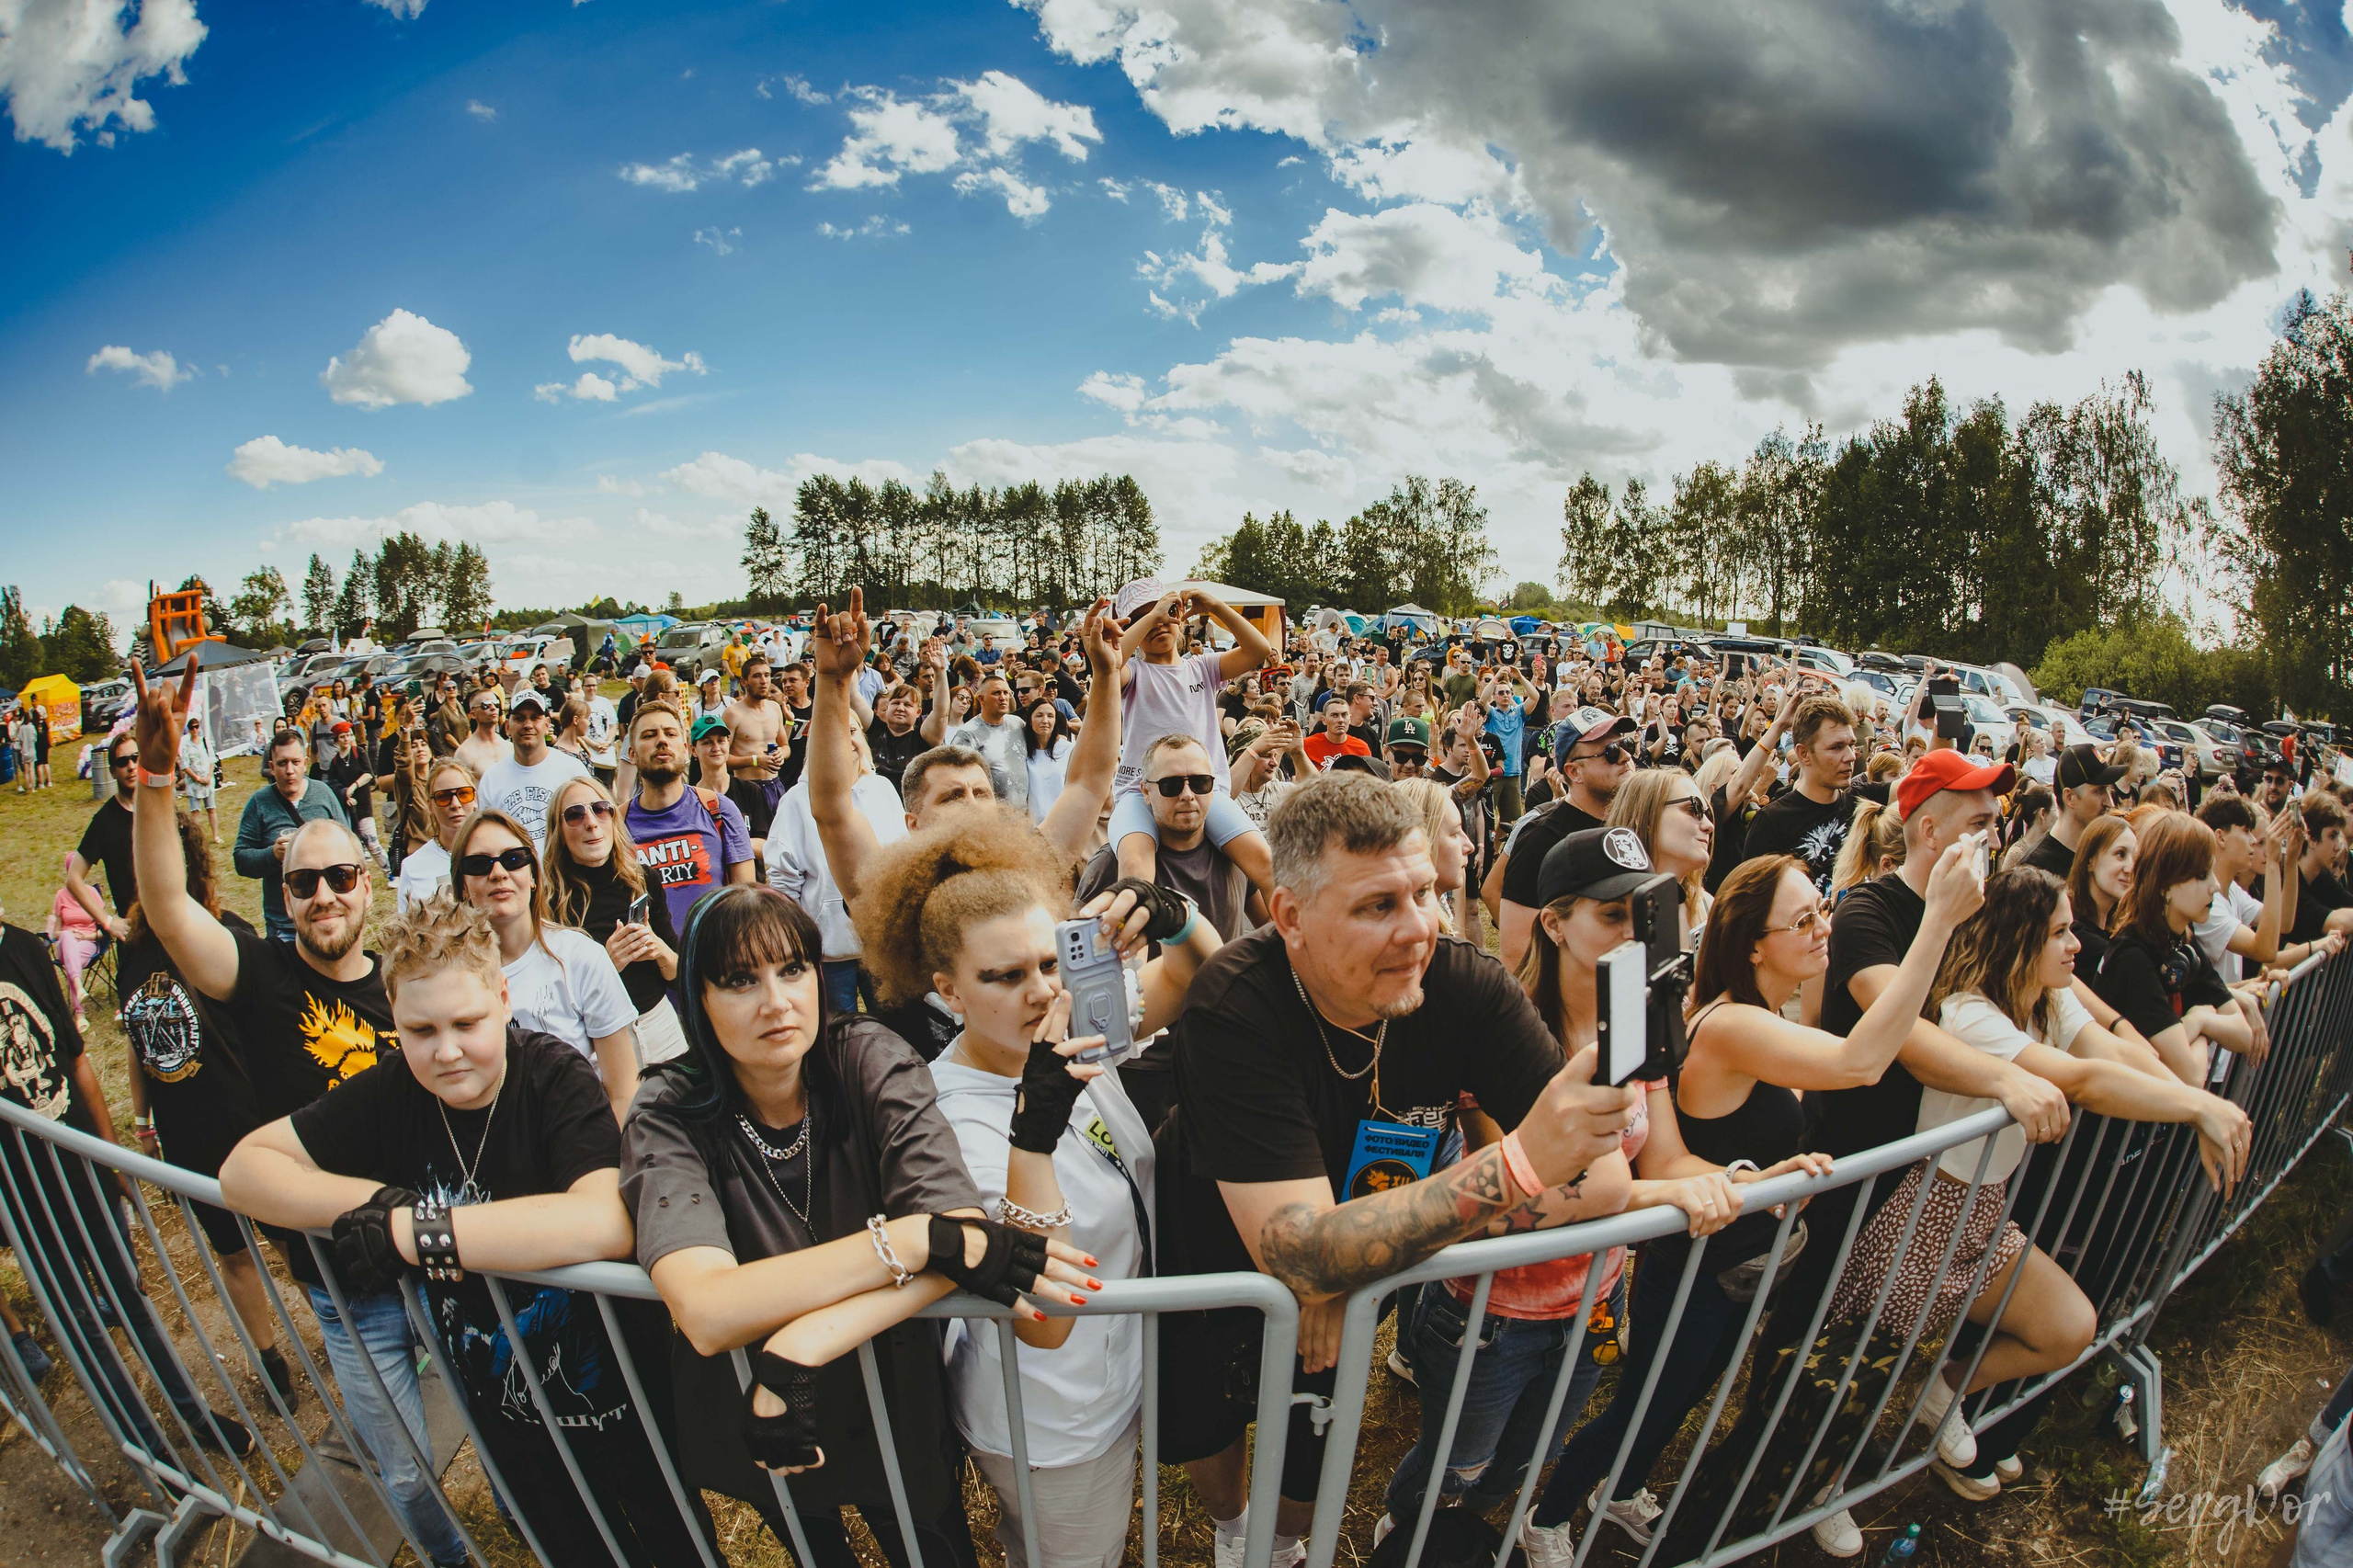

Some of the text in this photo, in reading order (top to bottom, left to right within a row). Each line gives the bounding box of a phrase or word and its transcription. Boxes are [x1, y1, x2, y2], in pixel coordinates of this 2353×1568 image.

[1404, 720, 1415, 734] LA
[504, 790, 523, 811] ZE
[636, 838, 699, 868] ANTI-
[659, 862, 694, 884] RTY
[1364, 1144, 1426, 1158] ФЕСТИВАЛЯ
